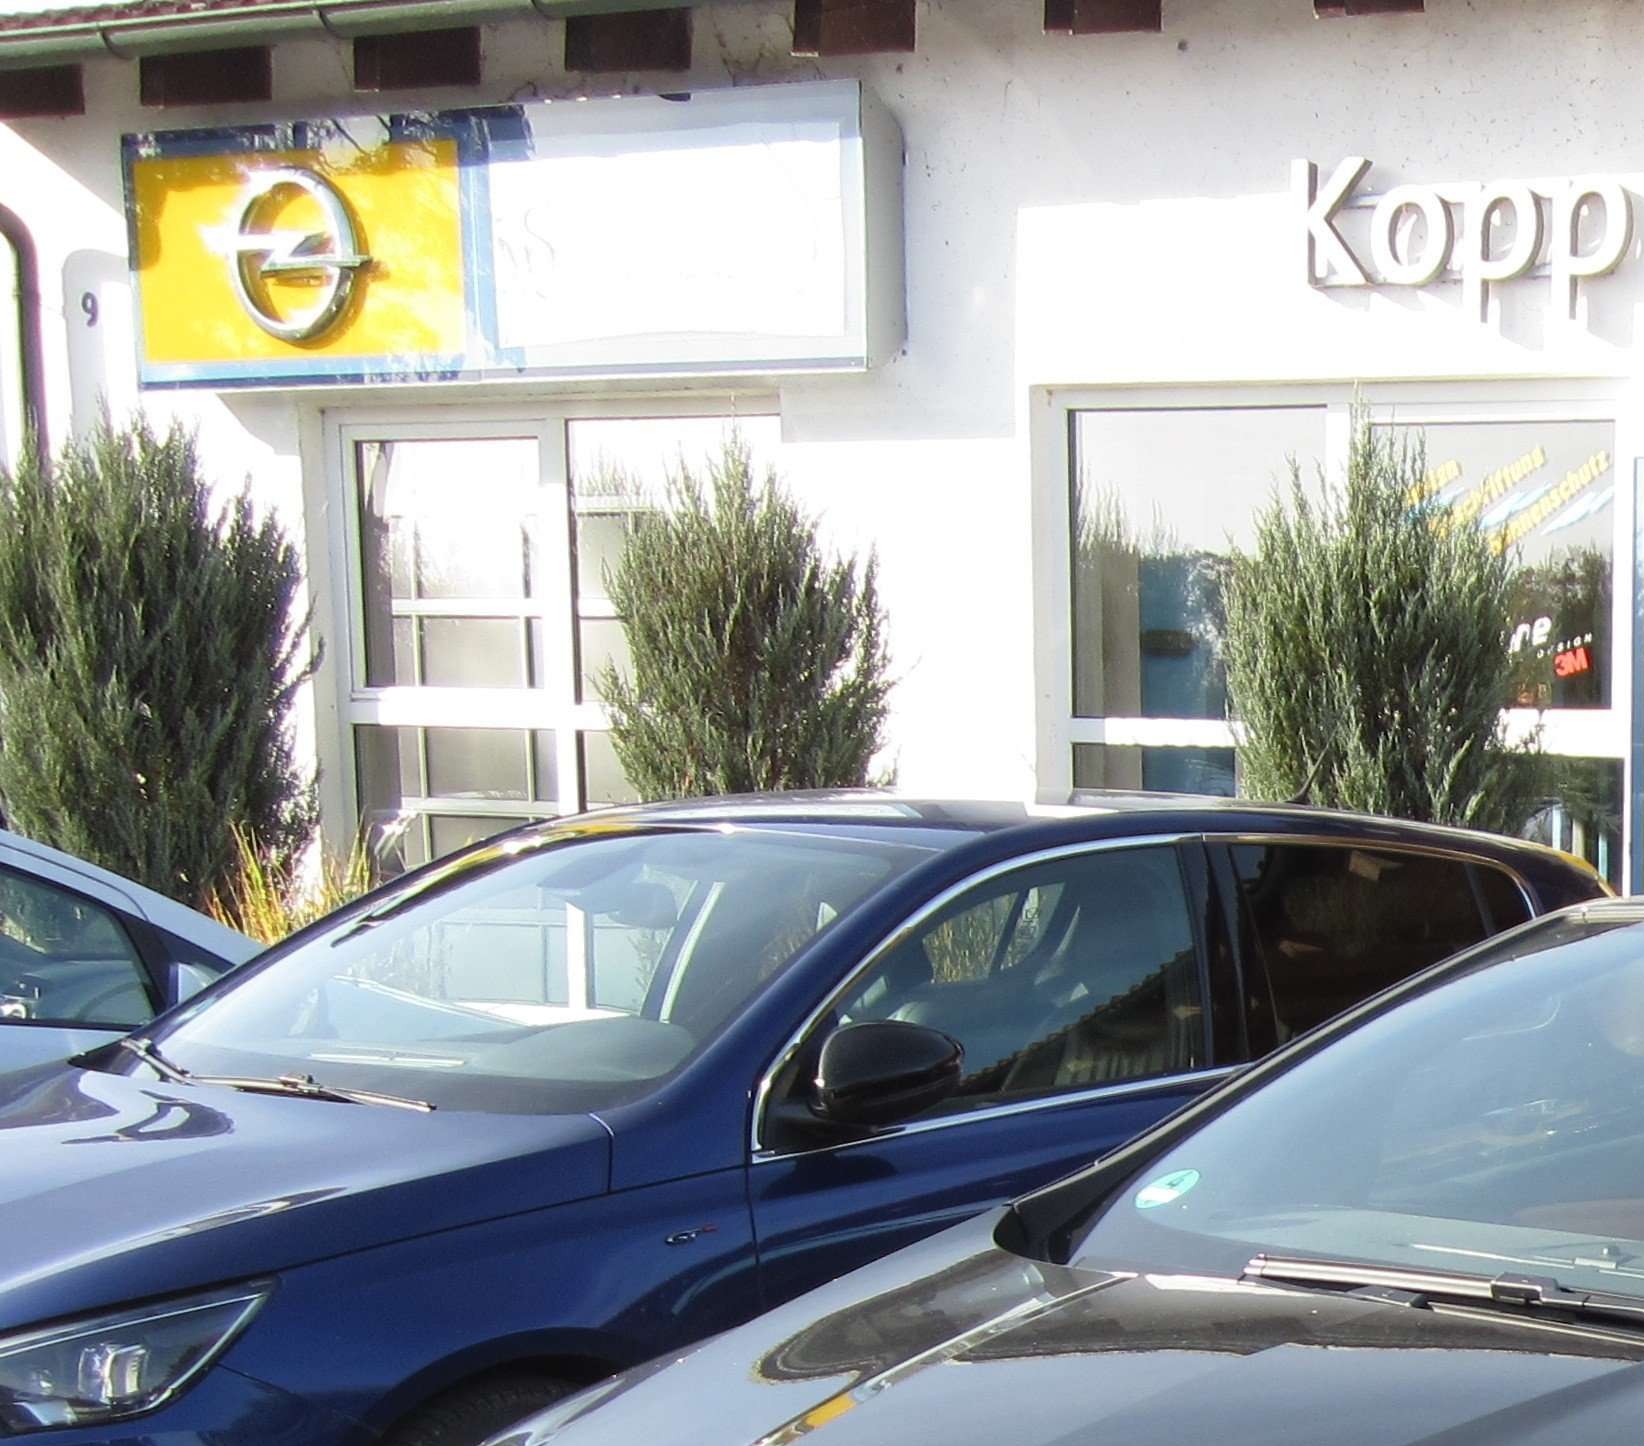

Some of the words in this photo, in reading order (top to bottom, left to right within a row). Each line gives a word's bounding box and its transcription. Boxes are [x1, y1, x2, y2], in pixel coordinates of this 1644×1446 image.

[1291, 156, 1636, 323] Kopp
[81, 291, 99, 328] 9
[1554, 647, 1589, 677] 3M
